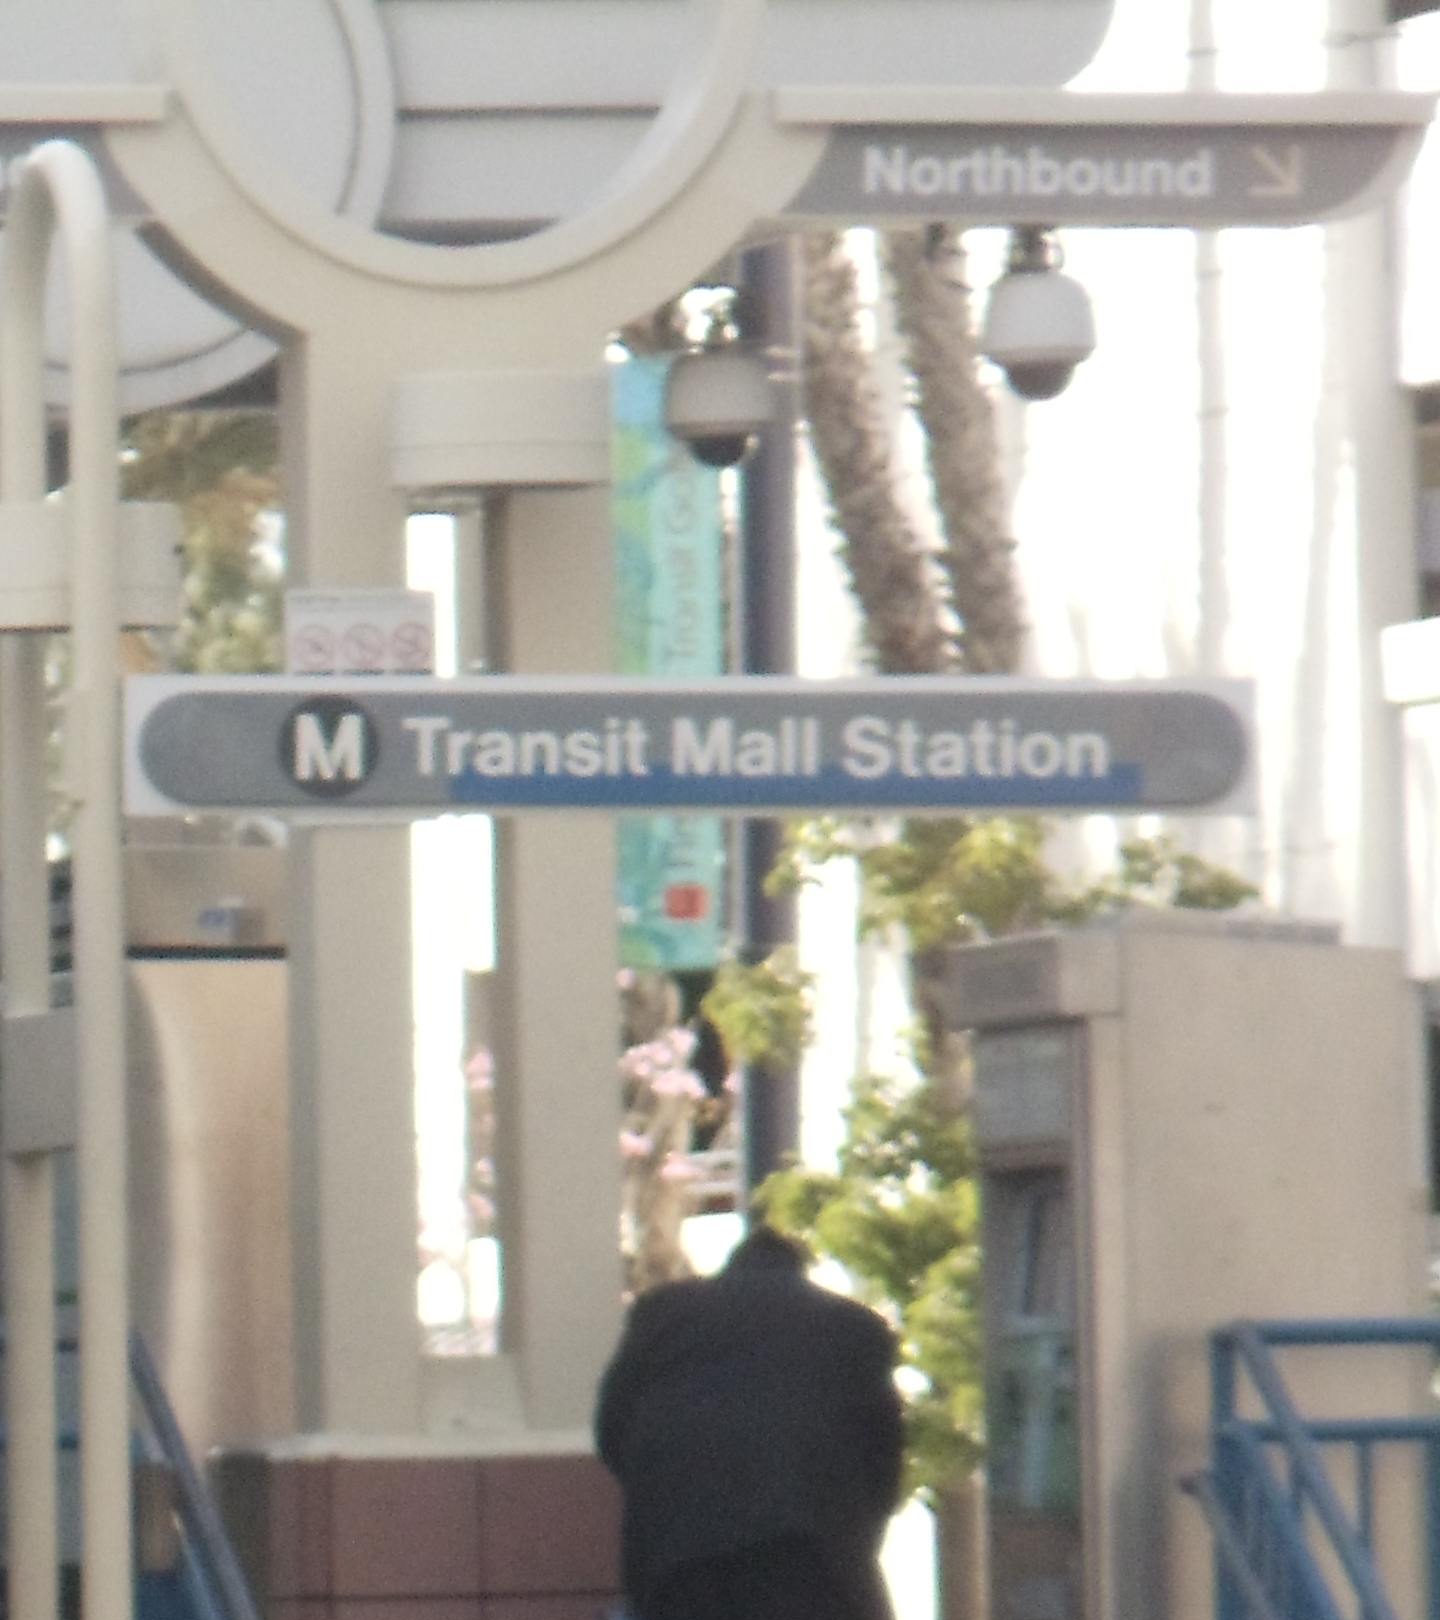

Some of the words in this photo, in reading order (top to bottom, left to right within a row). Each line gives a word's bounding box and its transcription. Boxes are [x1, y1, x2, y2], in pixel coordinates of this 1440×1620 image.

[863, 145, 1215, 197] Northbound
[294, 712, 362, 780] M
[401, 715, 650, 777] Transit
[670, 716, 818, 777] Mall
[841, 714, 1109, 778] Station
